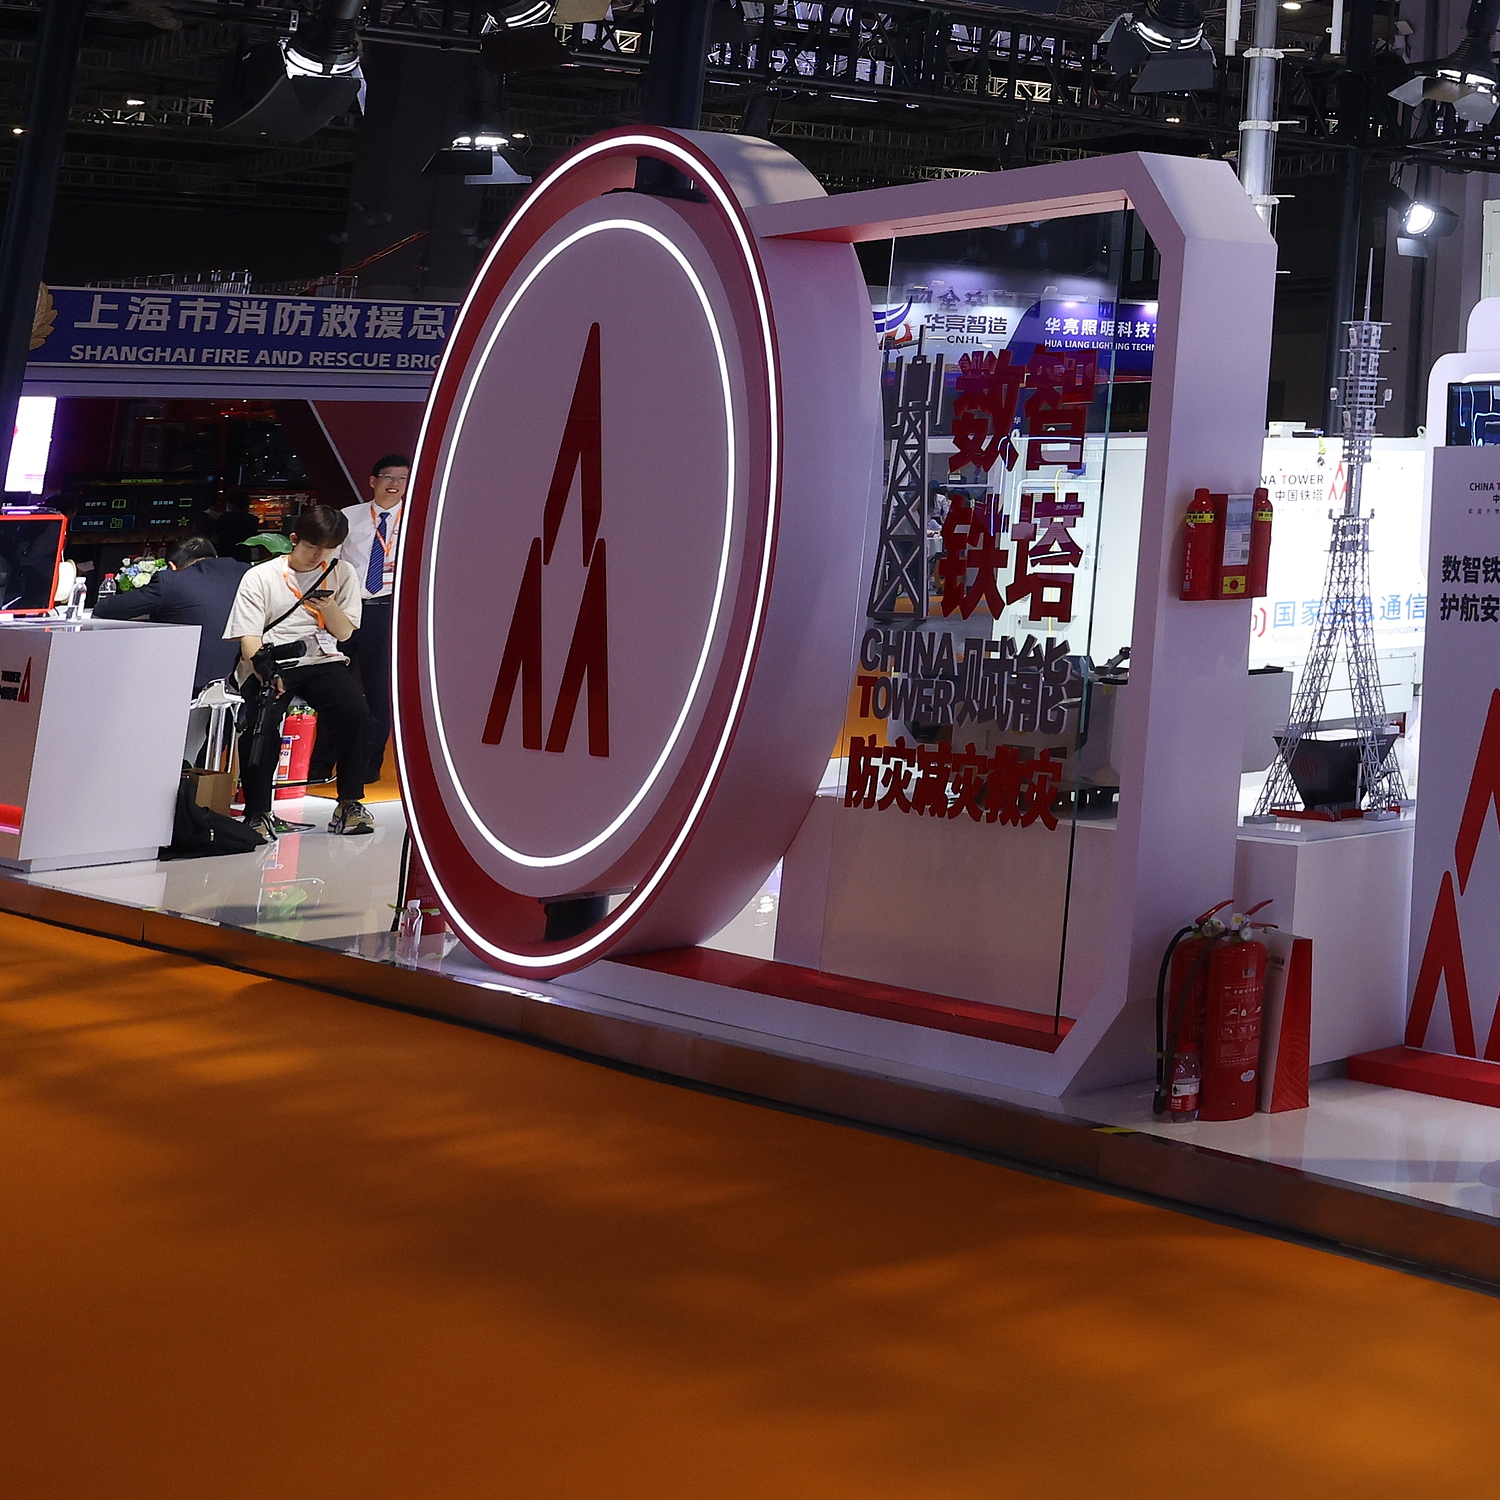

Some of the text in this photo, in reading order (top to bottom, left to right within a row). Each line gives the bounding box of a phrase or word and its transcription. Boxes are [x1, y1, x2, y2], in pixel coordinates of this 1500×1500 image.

[73, 294, 446, 340] 上海市消防救援总
[924, 313, 1007, 335] 华亮智造
[70, 344, 197, 363] SHANGHAI
[201, 348, 250, 365] FIRE
[254, 349, 304, 366] AND
[308, 351, 390, 368] RESCUE
[946, 334, 983, 345] CNHL
[1044, 339, 1063, 348] HUA
[1065, 340, 1090, 349] LIANG
[1092, 341, 1130, 350] LIGHTING
[948, 343, 1099, 473] 数智
[1275, 489, 1323, 502] 中国铁塔
[1281, 474, 1324, 485] TOWER
[1469, 482, 1495, 491] CHINA
[938, 492, 1085, 623] 铁塔
[860, 628, 959, 676] CHINA
[857, 675, 956, 725] TOWER
[955, 633, 1072, 734] 赋能
[844, 733, 1063, 832] 防灾减灾救灾
